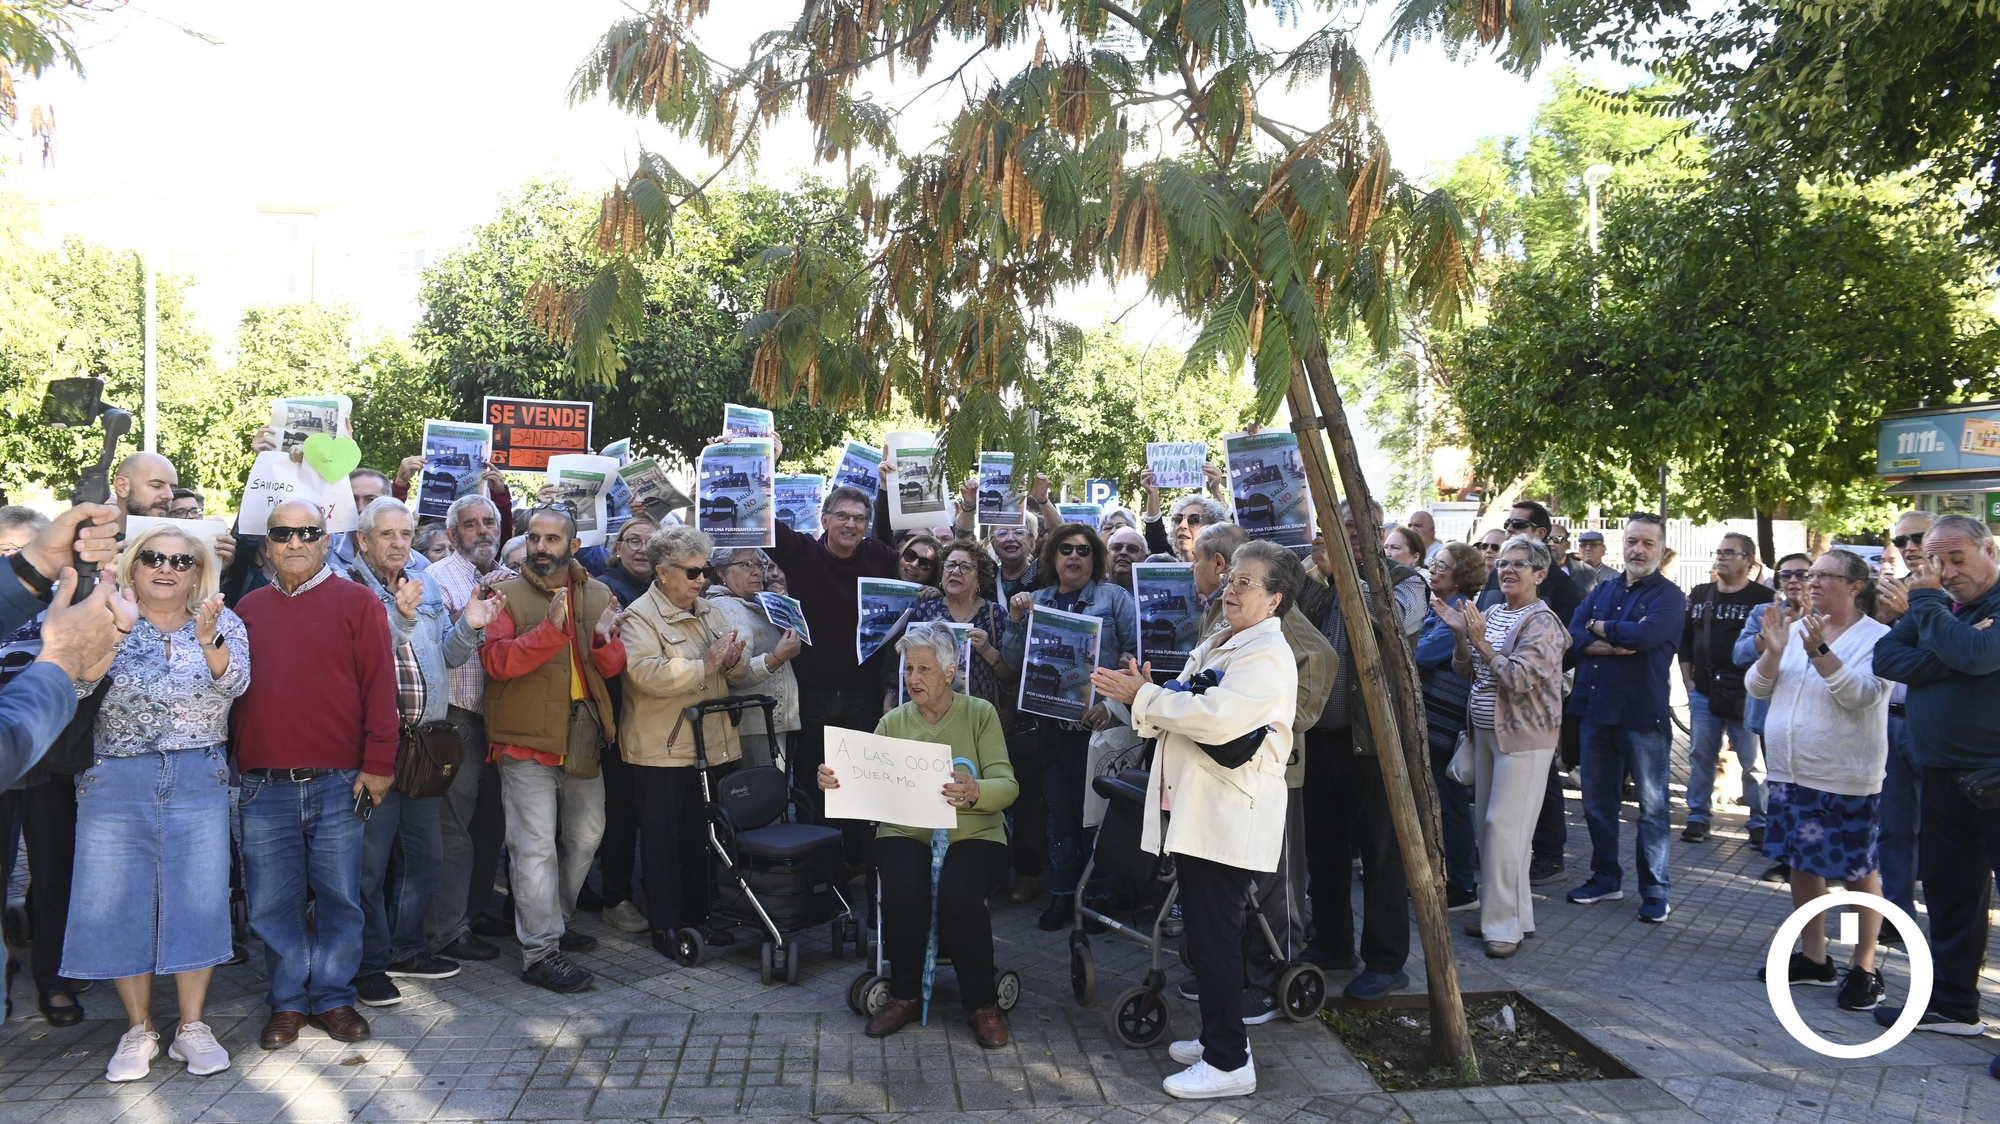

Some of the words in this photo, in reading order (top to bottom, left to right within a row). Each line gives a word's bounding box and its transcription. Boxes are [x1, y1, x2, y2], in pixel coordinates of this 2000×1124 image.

[489, 403, 516, 424] SE
[521, 405, 586, 428] VENDE
[511, 429, 582, 447] SANIDAD
[1898, 430, 1937, 454] 11/11
[456, 468, 474, 479] SALUD
[250, 477, 295, 493] SANIDAD
[462, 476, 474, 486] NO
[617, 490, 627, 500] NO
[736, 489, 754, 502] SALUD
[1092, 483, 1110, 504] P
[1270, 482, 1288, 498] SALUD
[743, 498, 757, 510] NO
[1278, 492, 1292, 505] NO
[740, 502, 770, 522] RESPONDE
[800, 509, 810, 517] NO
[1278, 494, 1306, 519] RESPONDE
[1264, 524, 1291, 532] FUENSANTA
[1716, 604, 1749, 620] LIFE
[1174, 613, 1191, 625] SALUD
[1181, 622, 1193, 633] NO
[1061, 663, 1078, 673] SALUD
[1066, 672, 1079, 682] NO
[1046, 694, 1071, 704] FUENSANTA
[836, 738, 851, 760] A
[863, 746, 894, 766] LAS
